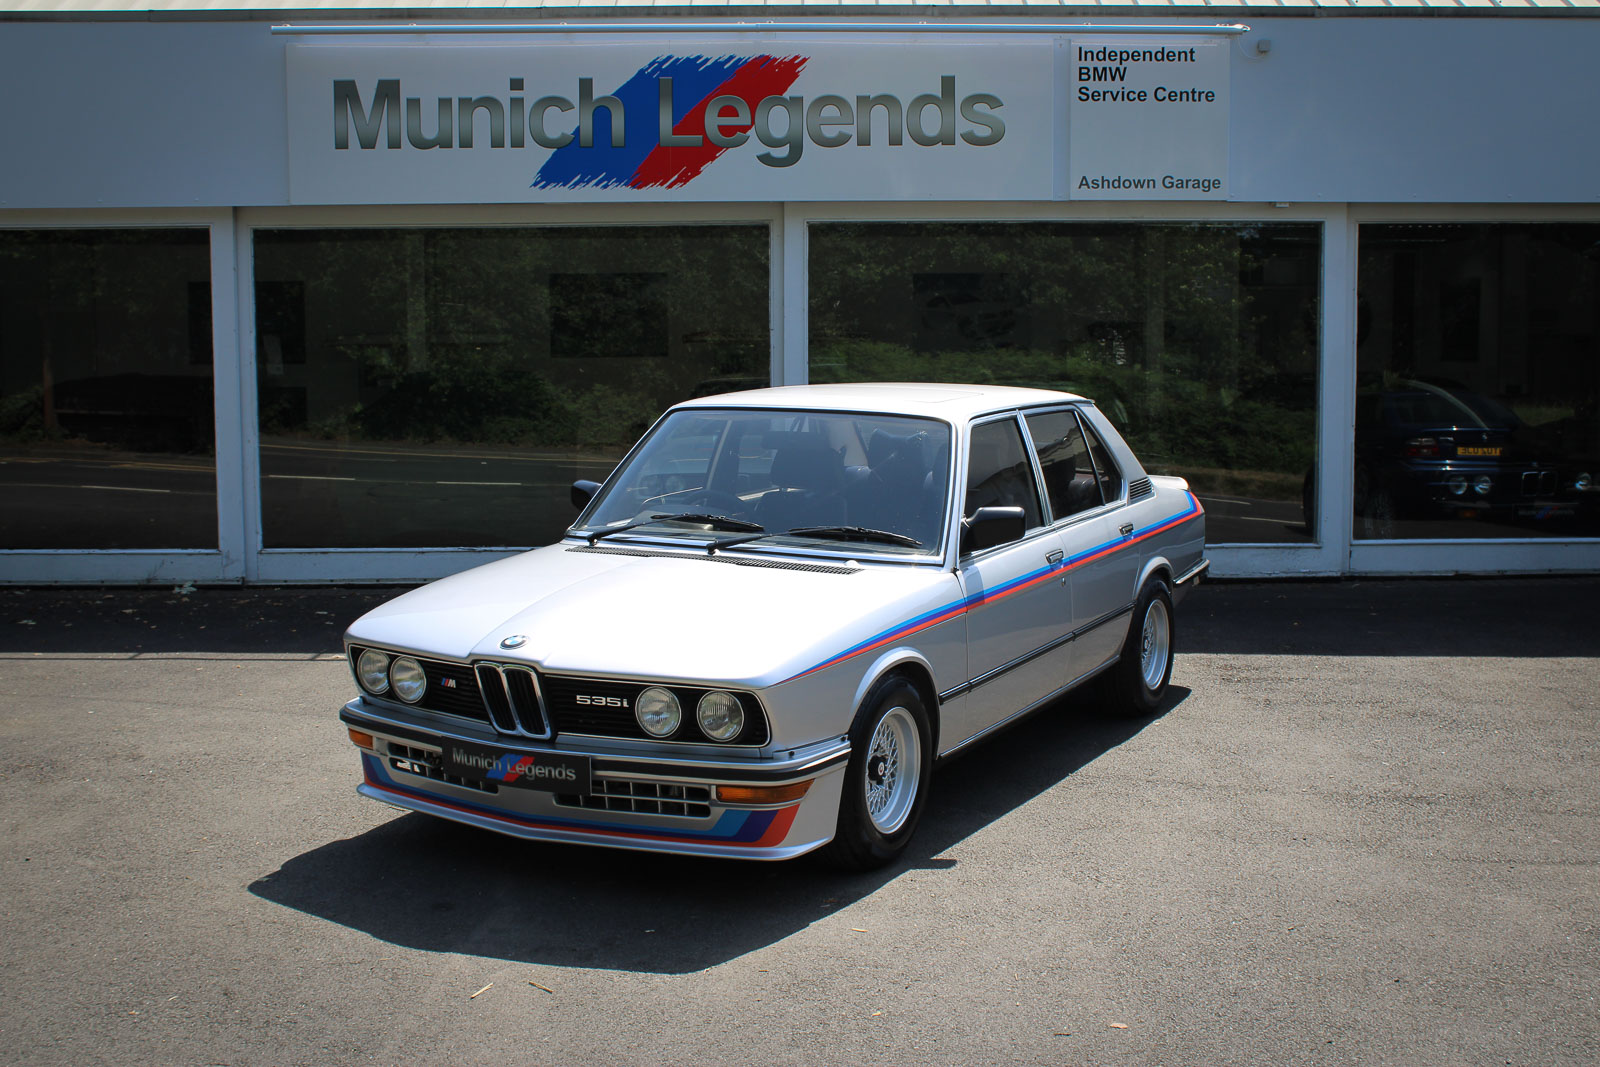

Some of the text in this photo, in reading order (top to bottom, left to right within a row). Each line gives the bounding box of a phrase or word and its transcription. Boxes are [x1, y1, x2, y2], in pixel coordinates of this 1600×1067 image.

[1078, 46, 1196, 65] Independent
[1078, 66, 1127, 82] BMW
[1078, 86, 1216, 102] Service Centre
[334, 75, 1006, 168] Munich Legends
[1078, 175, 1221, 192] Ashdown Garage
[575, 694, 630, 708] 535i
[452, 747, 577, 781] Munich Legends
